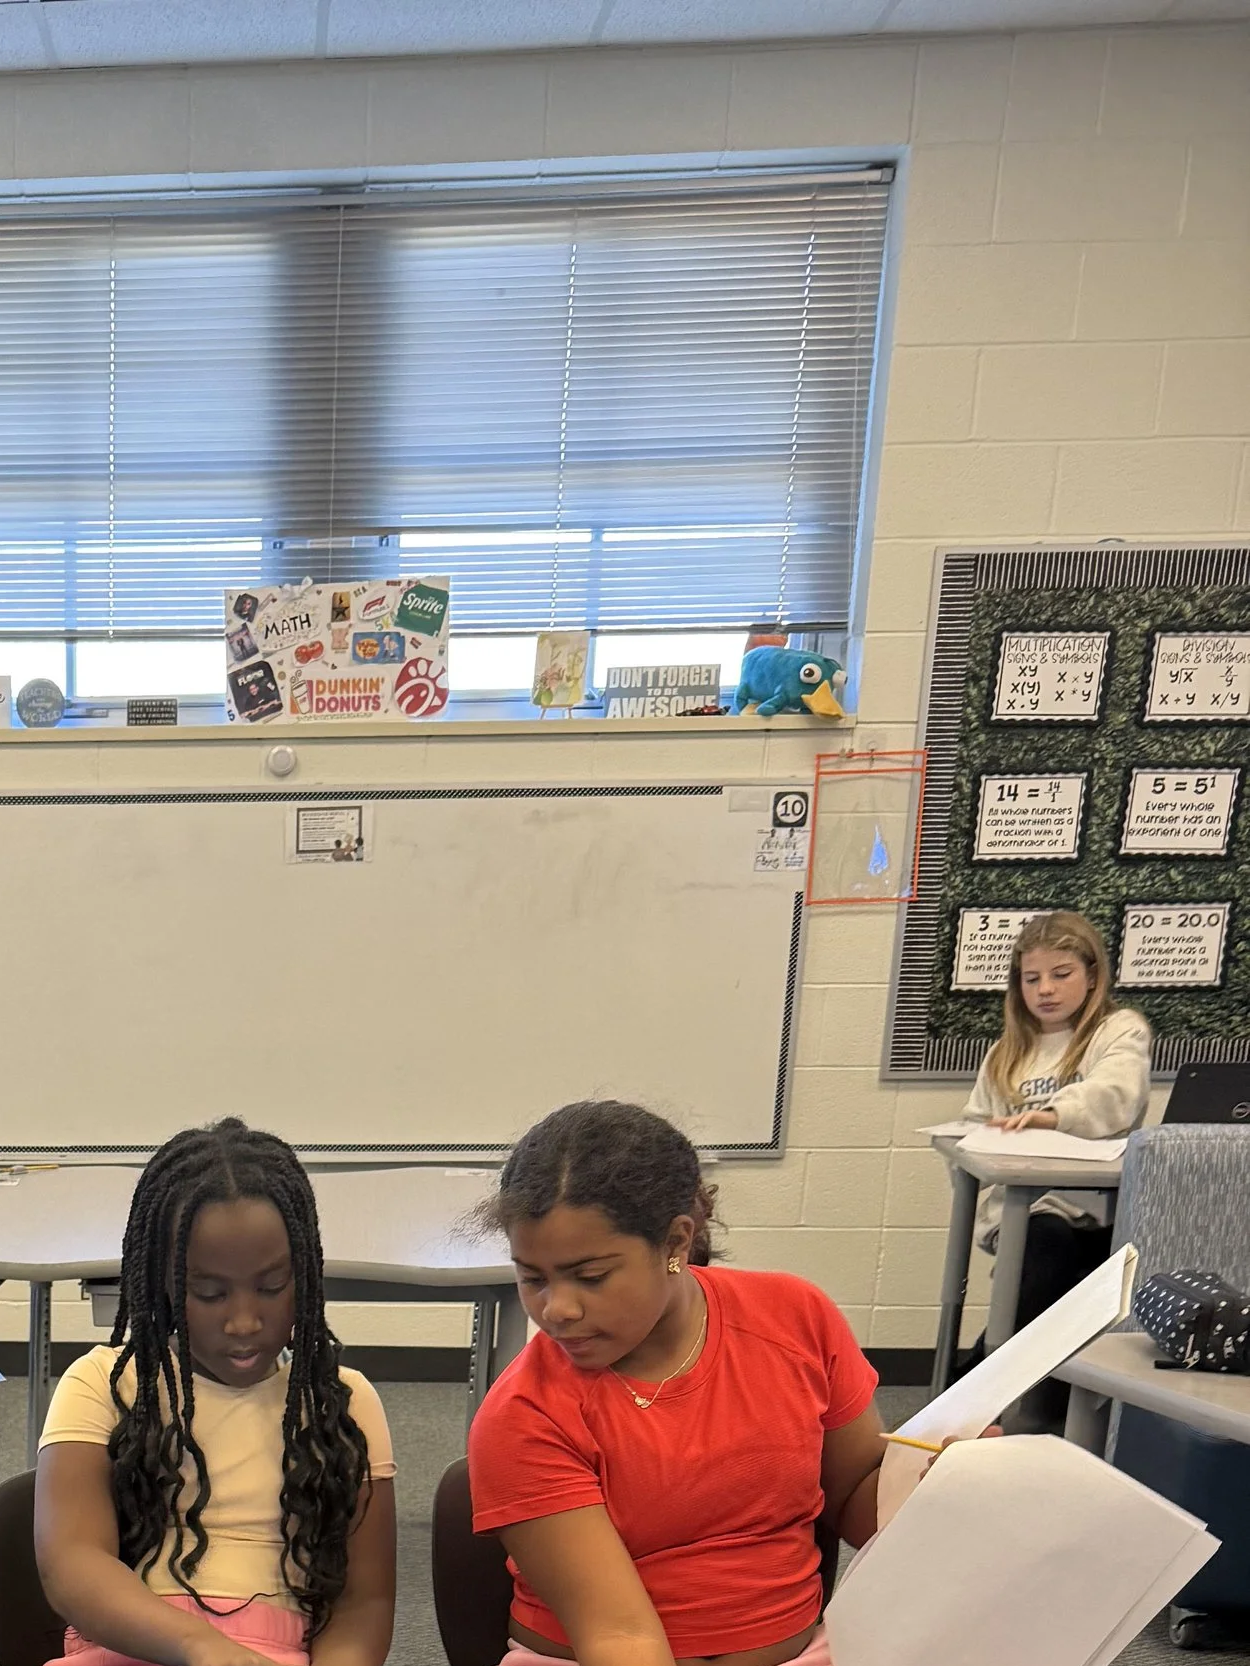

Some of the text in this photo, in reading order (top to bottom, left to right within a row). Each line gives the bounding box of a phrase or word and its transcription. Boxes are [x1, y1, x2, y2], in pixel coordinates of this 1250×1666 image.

[403, 592, 444, 614] Sprite
[264, 613, 312, 639] MATH
[1007, 638, 1103, 652] MULTIPLICATION
[1182, 639, 1236, 653] DIVISION
[1006, 652, 1038, 664] SIGNS
[1160, 652, 1191, 664] SIGNS
[609, 665, 719, 689] DON'T FORGET
[315, 676, 385, 696] DUNKIN'
[646, 688, 662, 696] TO
[315, 695, 381, 714] DONUTS
[996, 783, 1019, 802] 14
[1048, 781, 1061, 792] 14
[1151, 777, 1166, 795] 5
[779, 799, 804, 817] 10
[1000, 807, 1030, 816] whole
[1031, 806, 1072, 815] numbers
[1145, 800, 1215, 812] Every whole
[985, 819, 1003, 827] can
[1004, 818, 1017, 827] be
[1053, 818, 1065, 826] as
[1066, 818, 1074, 826] a
[1135, 814, 1221, 825] number has an
[1055, 828, 1063, 836] a
[1128, 827, 1181, 838] exponent
[1183, 827, 1198, 837] of
[1047, 839, 1059, 847] of
[978, 914, 990, 931] 3
[1130, 914, 1155, 929] 20
[1177, 913, 1220, 929] 20.0
[980, 933, 987, 941] a
